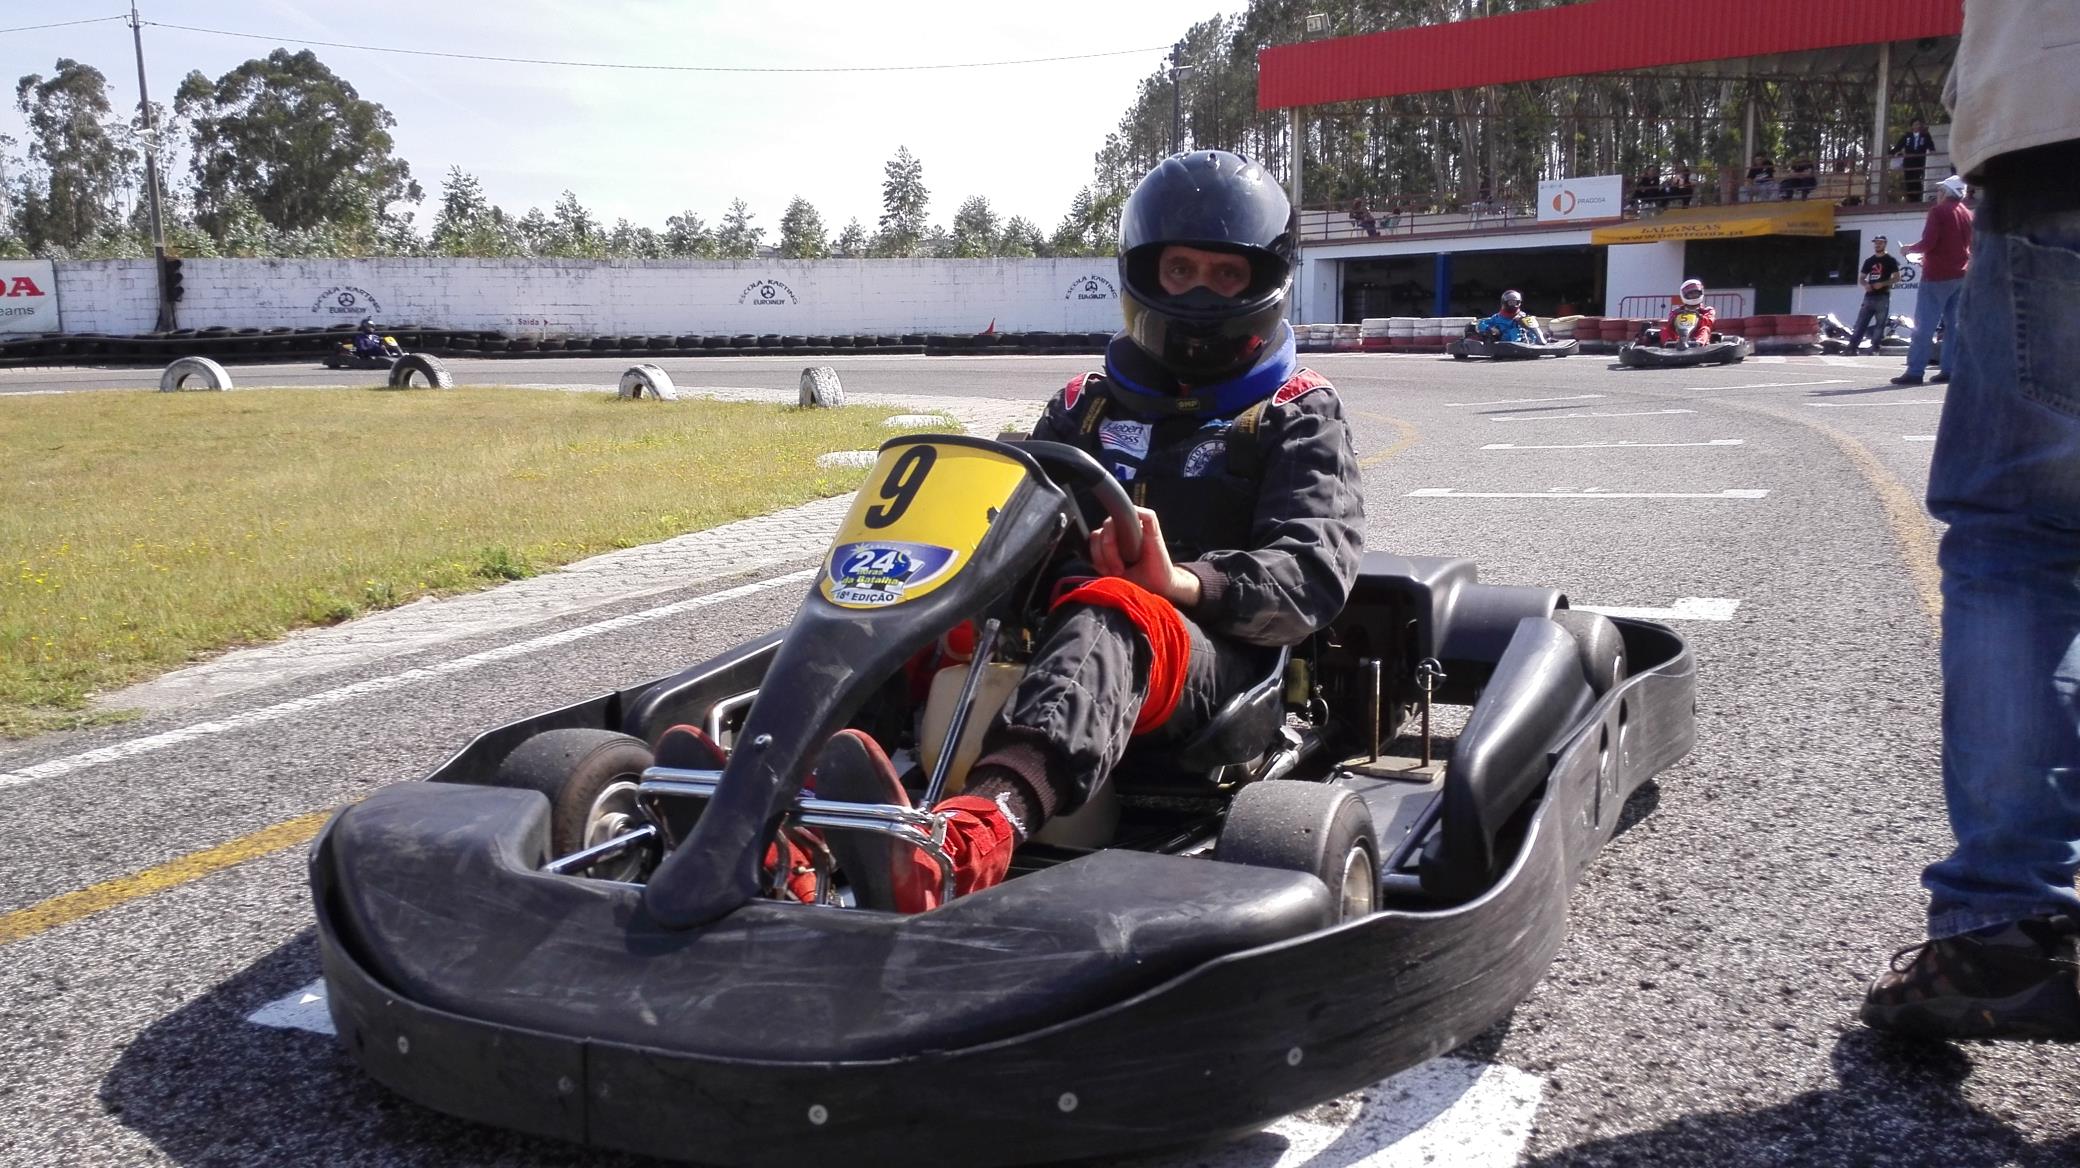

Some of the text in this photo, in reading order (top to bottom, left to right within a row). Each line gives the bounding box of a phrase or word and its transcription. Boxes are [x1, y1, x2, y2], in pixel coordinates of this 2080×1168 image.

[738, 279, 798, 304] ESCOLA KARTING
[1065, 275, 1118, 300] ESCOLA KARTING
[864, 444, 937, 529] 9
[848, 550, 898, 573] 24
[857, 575, 899, 585] Batalha
[851, 592, 894, 602] EDIÇÃO
